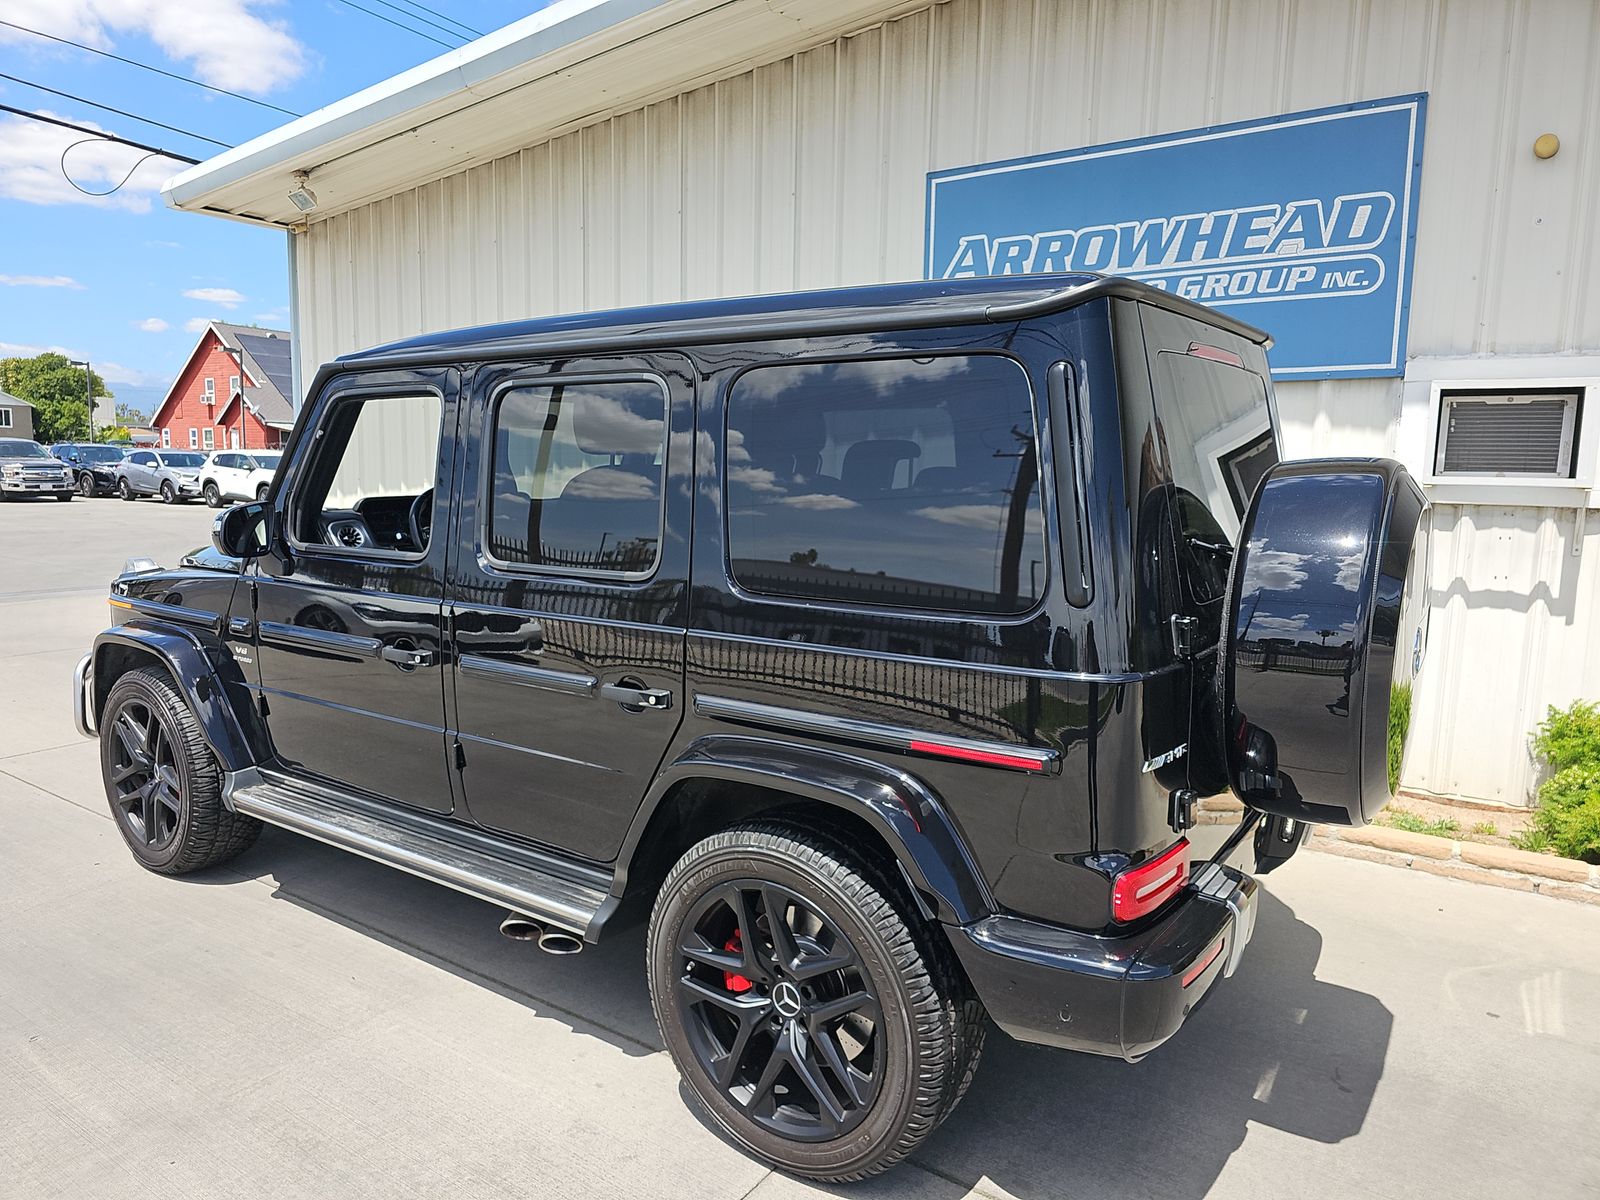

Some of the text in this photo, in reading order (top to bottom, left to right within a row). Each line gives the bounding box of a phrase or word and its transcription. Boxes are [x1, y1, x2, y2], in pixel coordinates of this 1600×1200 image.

[943, 191, 1396, 276] ARROWHEAD
[1176, 266, 1317, 299] GROUP
[1321, 269, 1369, 289] INC.
